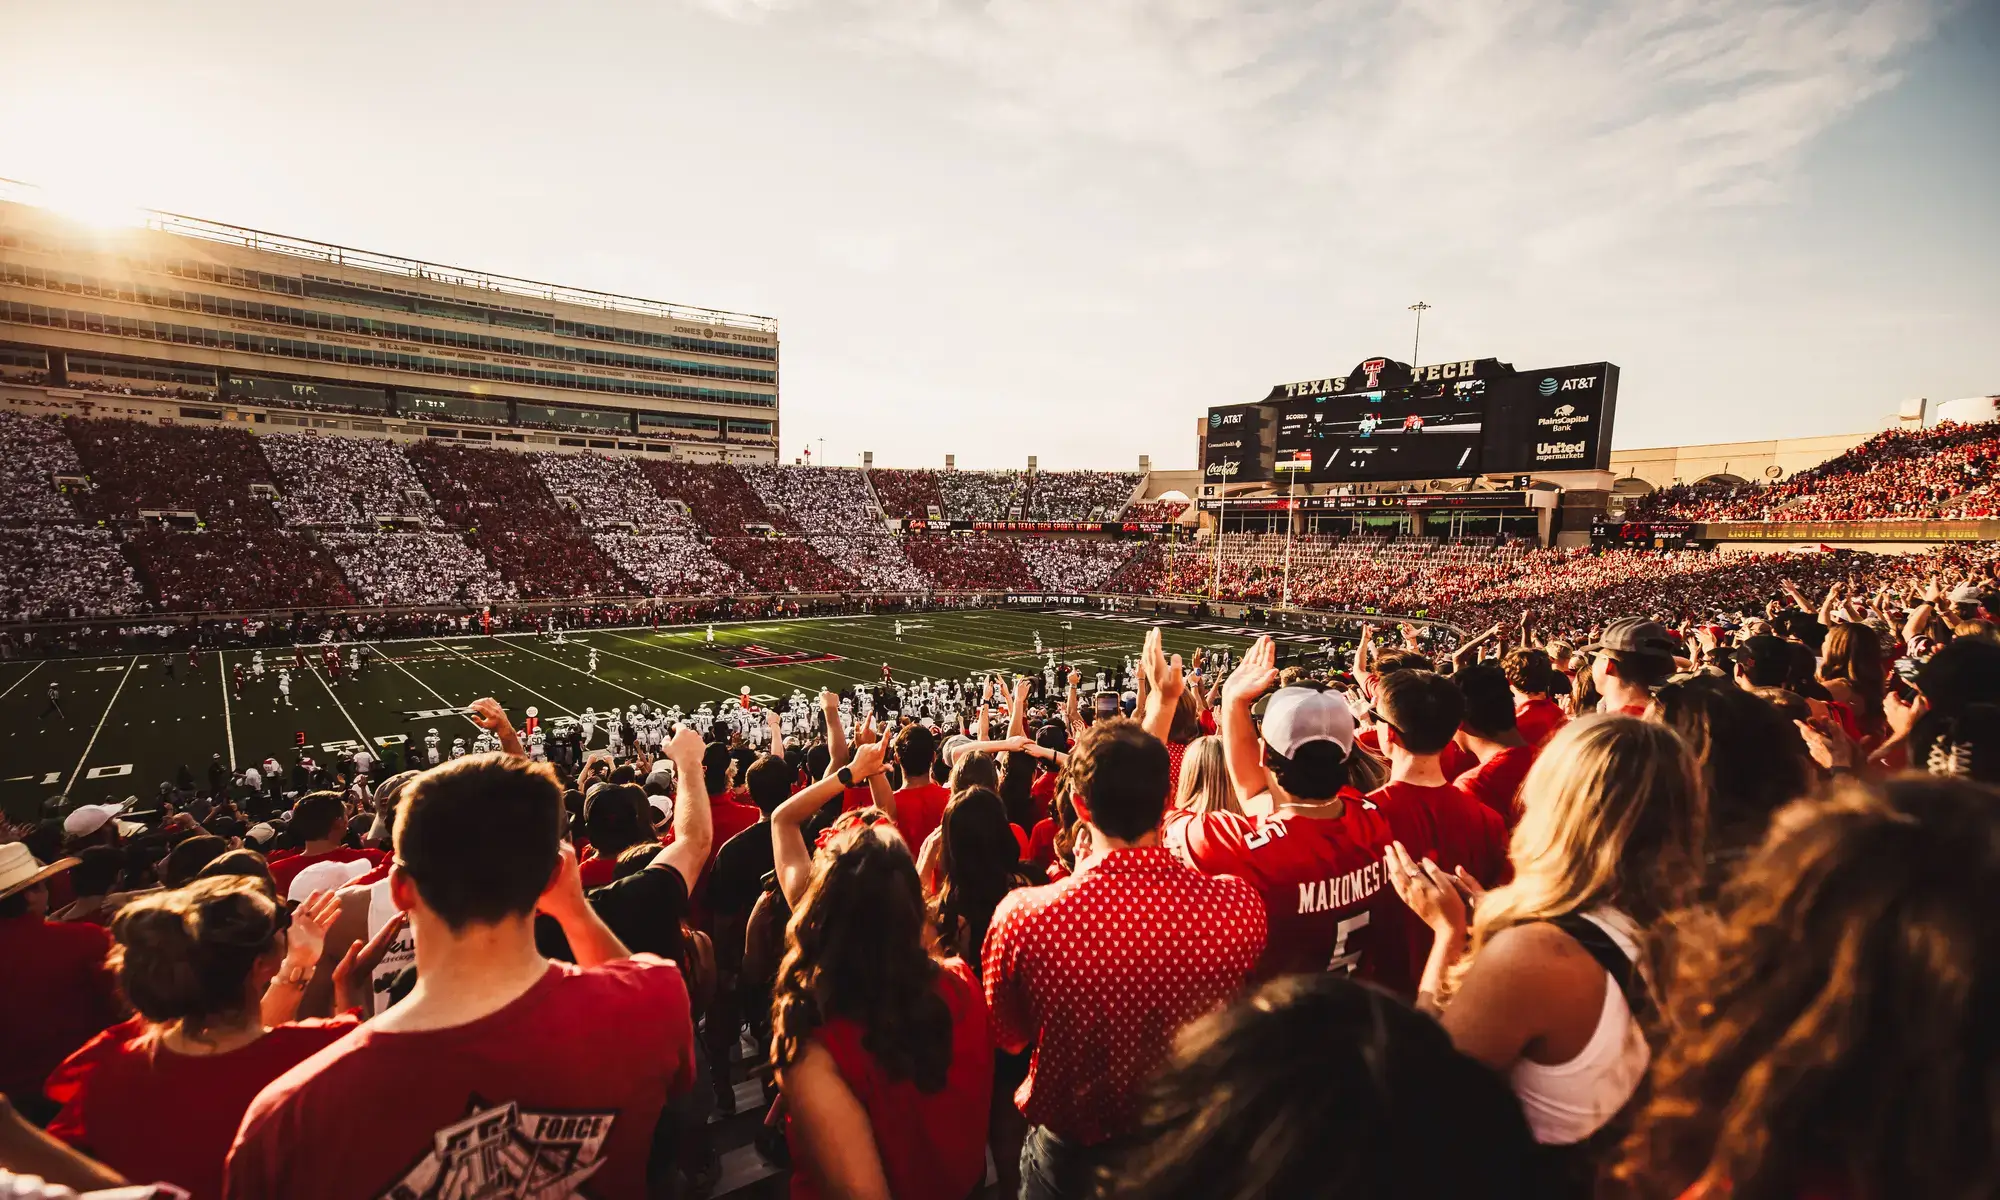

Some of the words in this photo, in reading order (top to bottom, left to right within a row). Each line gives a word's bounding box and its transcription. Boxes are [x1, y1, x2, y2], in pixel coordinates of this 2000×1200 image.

[673, 325, 701, 336] JONES
[713, 331, 730, 339] AT&T
[732, 334, 768, 344] STADIUM
[457, 352, 486, 361] ANDERSON
[1285, 377, 1347, 398] TEXAS
[1410, 360, 1477, 383] TECH
[1561, 376, 1597, 391] AT&T
[6, 398, 73, 409] TEXAS
[98, 406, 152, 415] TECH
[1223, 413, 1243, 425] AT&T
[1538, 415, 1589, 425] PlainsCapital
[1553, 424, 1571, 432] Bank
[1536, 441, 1585, 454] United
[1536, 452, 1584, 461] supermarkets
[1521, 476, 1528, 486] 5
[972, 522, 992, 531] LISTEN
[994, 522, 1006, 531] LIVE
[1008, 522, 1016, 531] ON
[1018, 522, 1035, 531] TEXAS
[1037, 523, 1051, 532] TECH
[1053, 523, 1074, 532] SPORTS
[1076, 523, 1102, 531] NETWORK
[296, 732, 305, 745] 3
[531, 737, 543, 745] 50
[1298, 861, 1381, 914] MAHOMES
[1326, 910, 1370, 972] 5
[534, 1117, 603, 1140] FORCE
